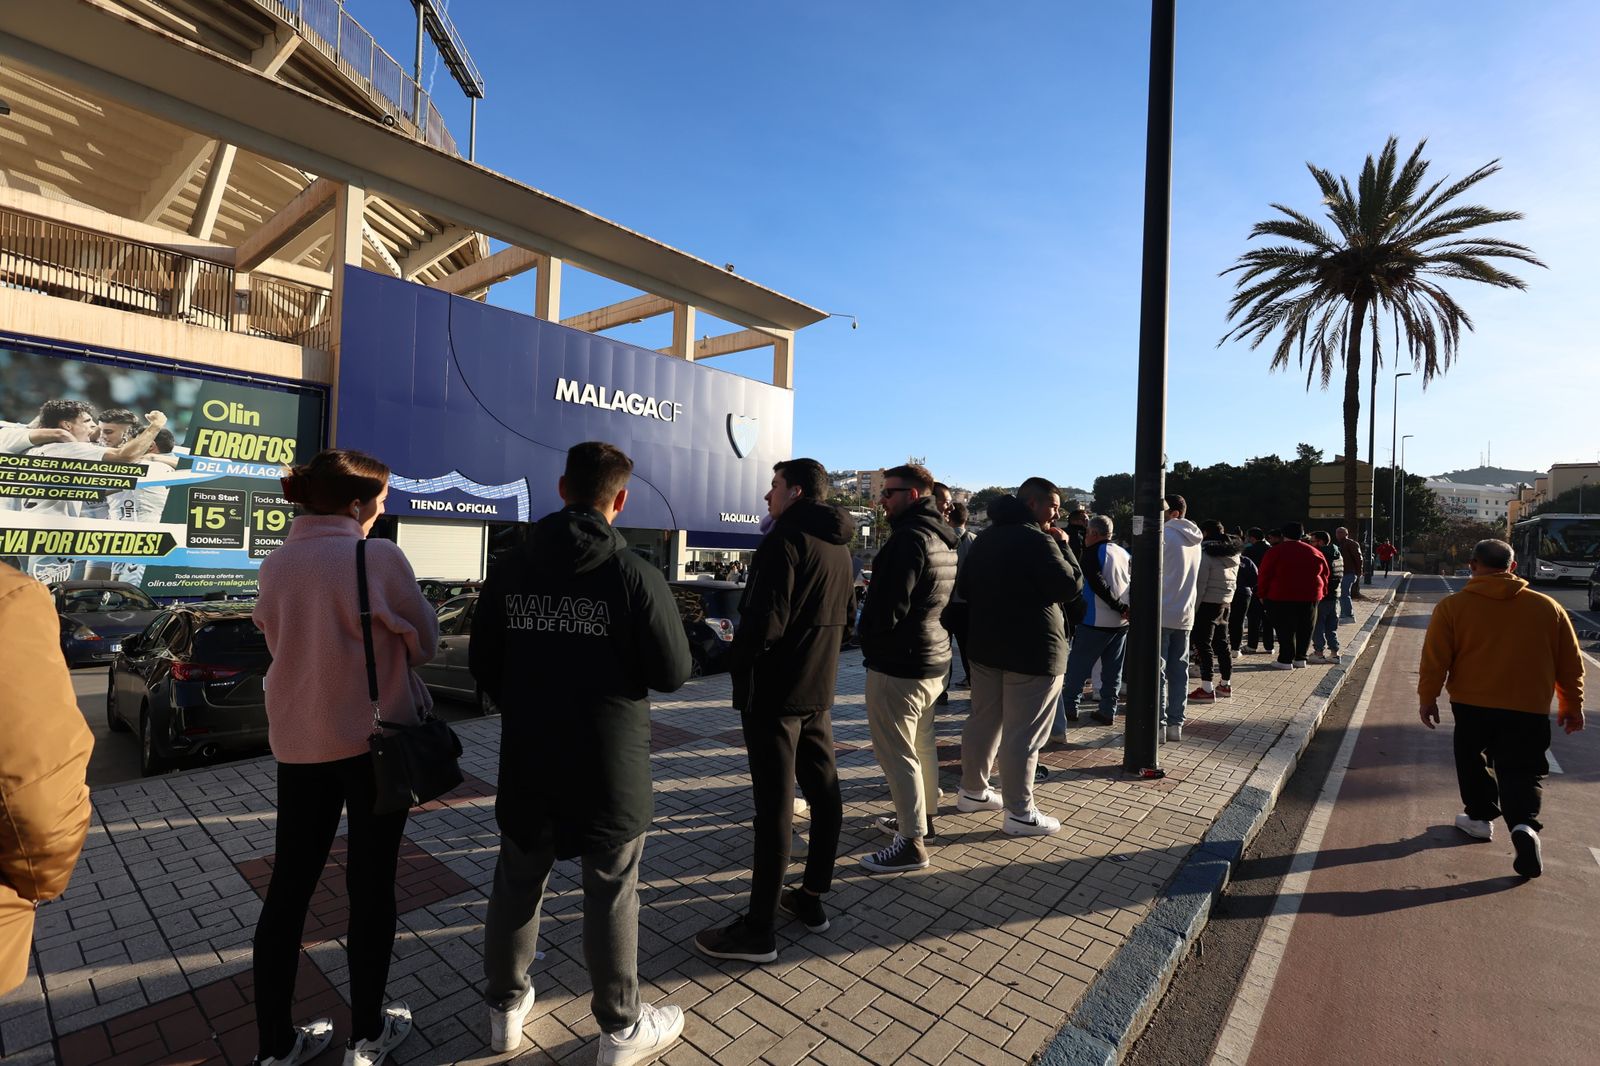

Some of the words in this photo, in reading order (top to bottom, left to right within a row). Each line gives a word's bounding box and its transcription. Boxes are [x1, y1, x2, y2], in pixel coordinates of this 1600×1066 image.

[202, 400, 260, 427] Olin
[194, 428, 296, 464] FOROFOS
[0, 456, 30, 466] POR
[32, 459, 58, 468] SER
[61, 461, 146, 476] MALAGUISTA,
[195, 461, 223, 473] DEL
[226, 463, 285, 477] MÁLAGA
[0, 471, 17, 480] TE
[18, 472, 69, 483] DAMOS
[72, 476, 131, 488] NUESTRA
[0, 486, 46, 496] MEJOR
[48, 488, 99, 499] OFERTA
[193, 492, 216, 500] Fibra
[254, 495, 274, 504] Todo
[123, 499, 135, 518] Olin
[410, 499, 454, 512] TIENDA
[456, 502, 498, 514] OFICIAL
[190, 506, 226, 529] 15
[229, 508, 237, 516] €
[252, 509, 286, 531] 19
[720, 512, 760, 524] TAQUILLAS
[30, 530, 74, 554] POR
[74, 532, 163, 555] USTEDES!
[190, 536, 222, 544] 300Mb
[254, 538, 284, 546] 300Mb
[254, 549, 274, 557] 20G
[147, 579, 258, 588] olin.es/forofos-malaguist
[505, 594, 611, 625] MALAGA
[506, 617, 534, 630] LUB
[536, 618, 556, 632] DE
[559, 619, 609, 636] FUTBOL
